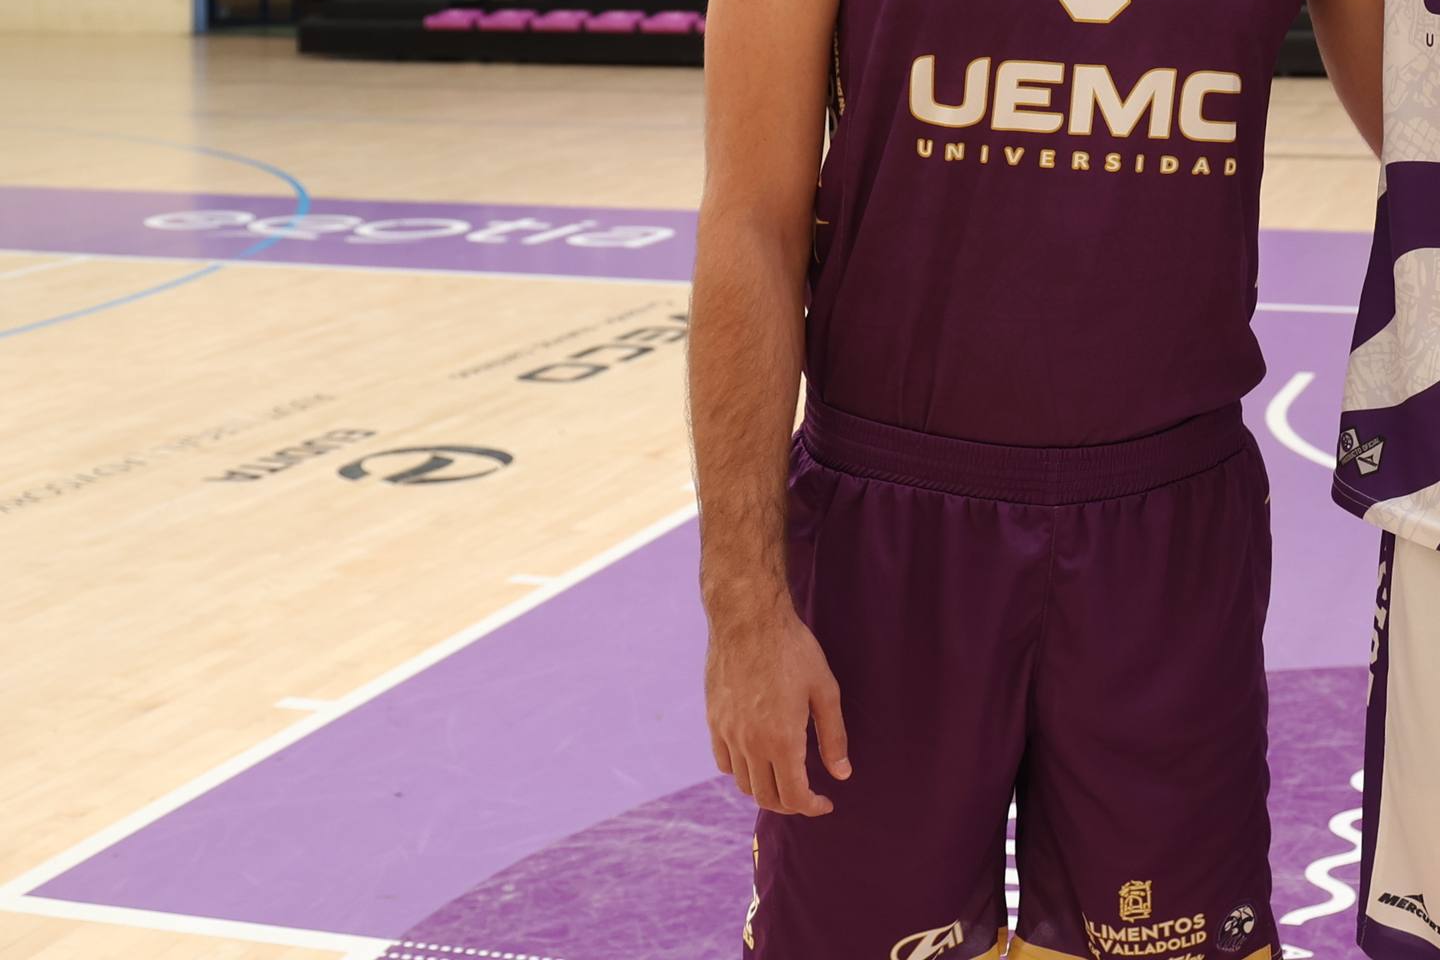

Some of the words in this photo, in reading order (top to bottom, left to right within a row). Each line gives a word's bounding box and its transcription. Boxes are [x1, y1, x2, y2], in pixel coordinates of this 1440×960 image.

[909, 54, 1243, 143] UEMC
[916, 138, 1238, 176] UNIVERSIDAD
[1098, 931, 1207, 956] VALLADOLID
